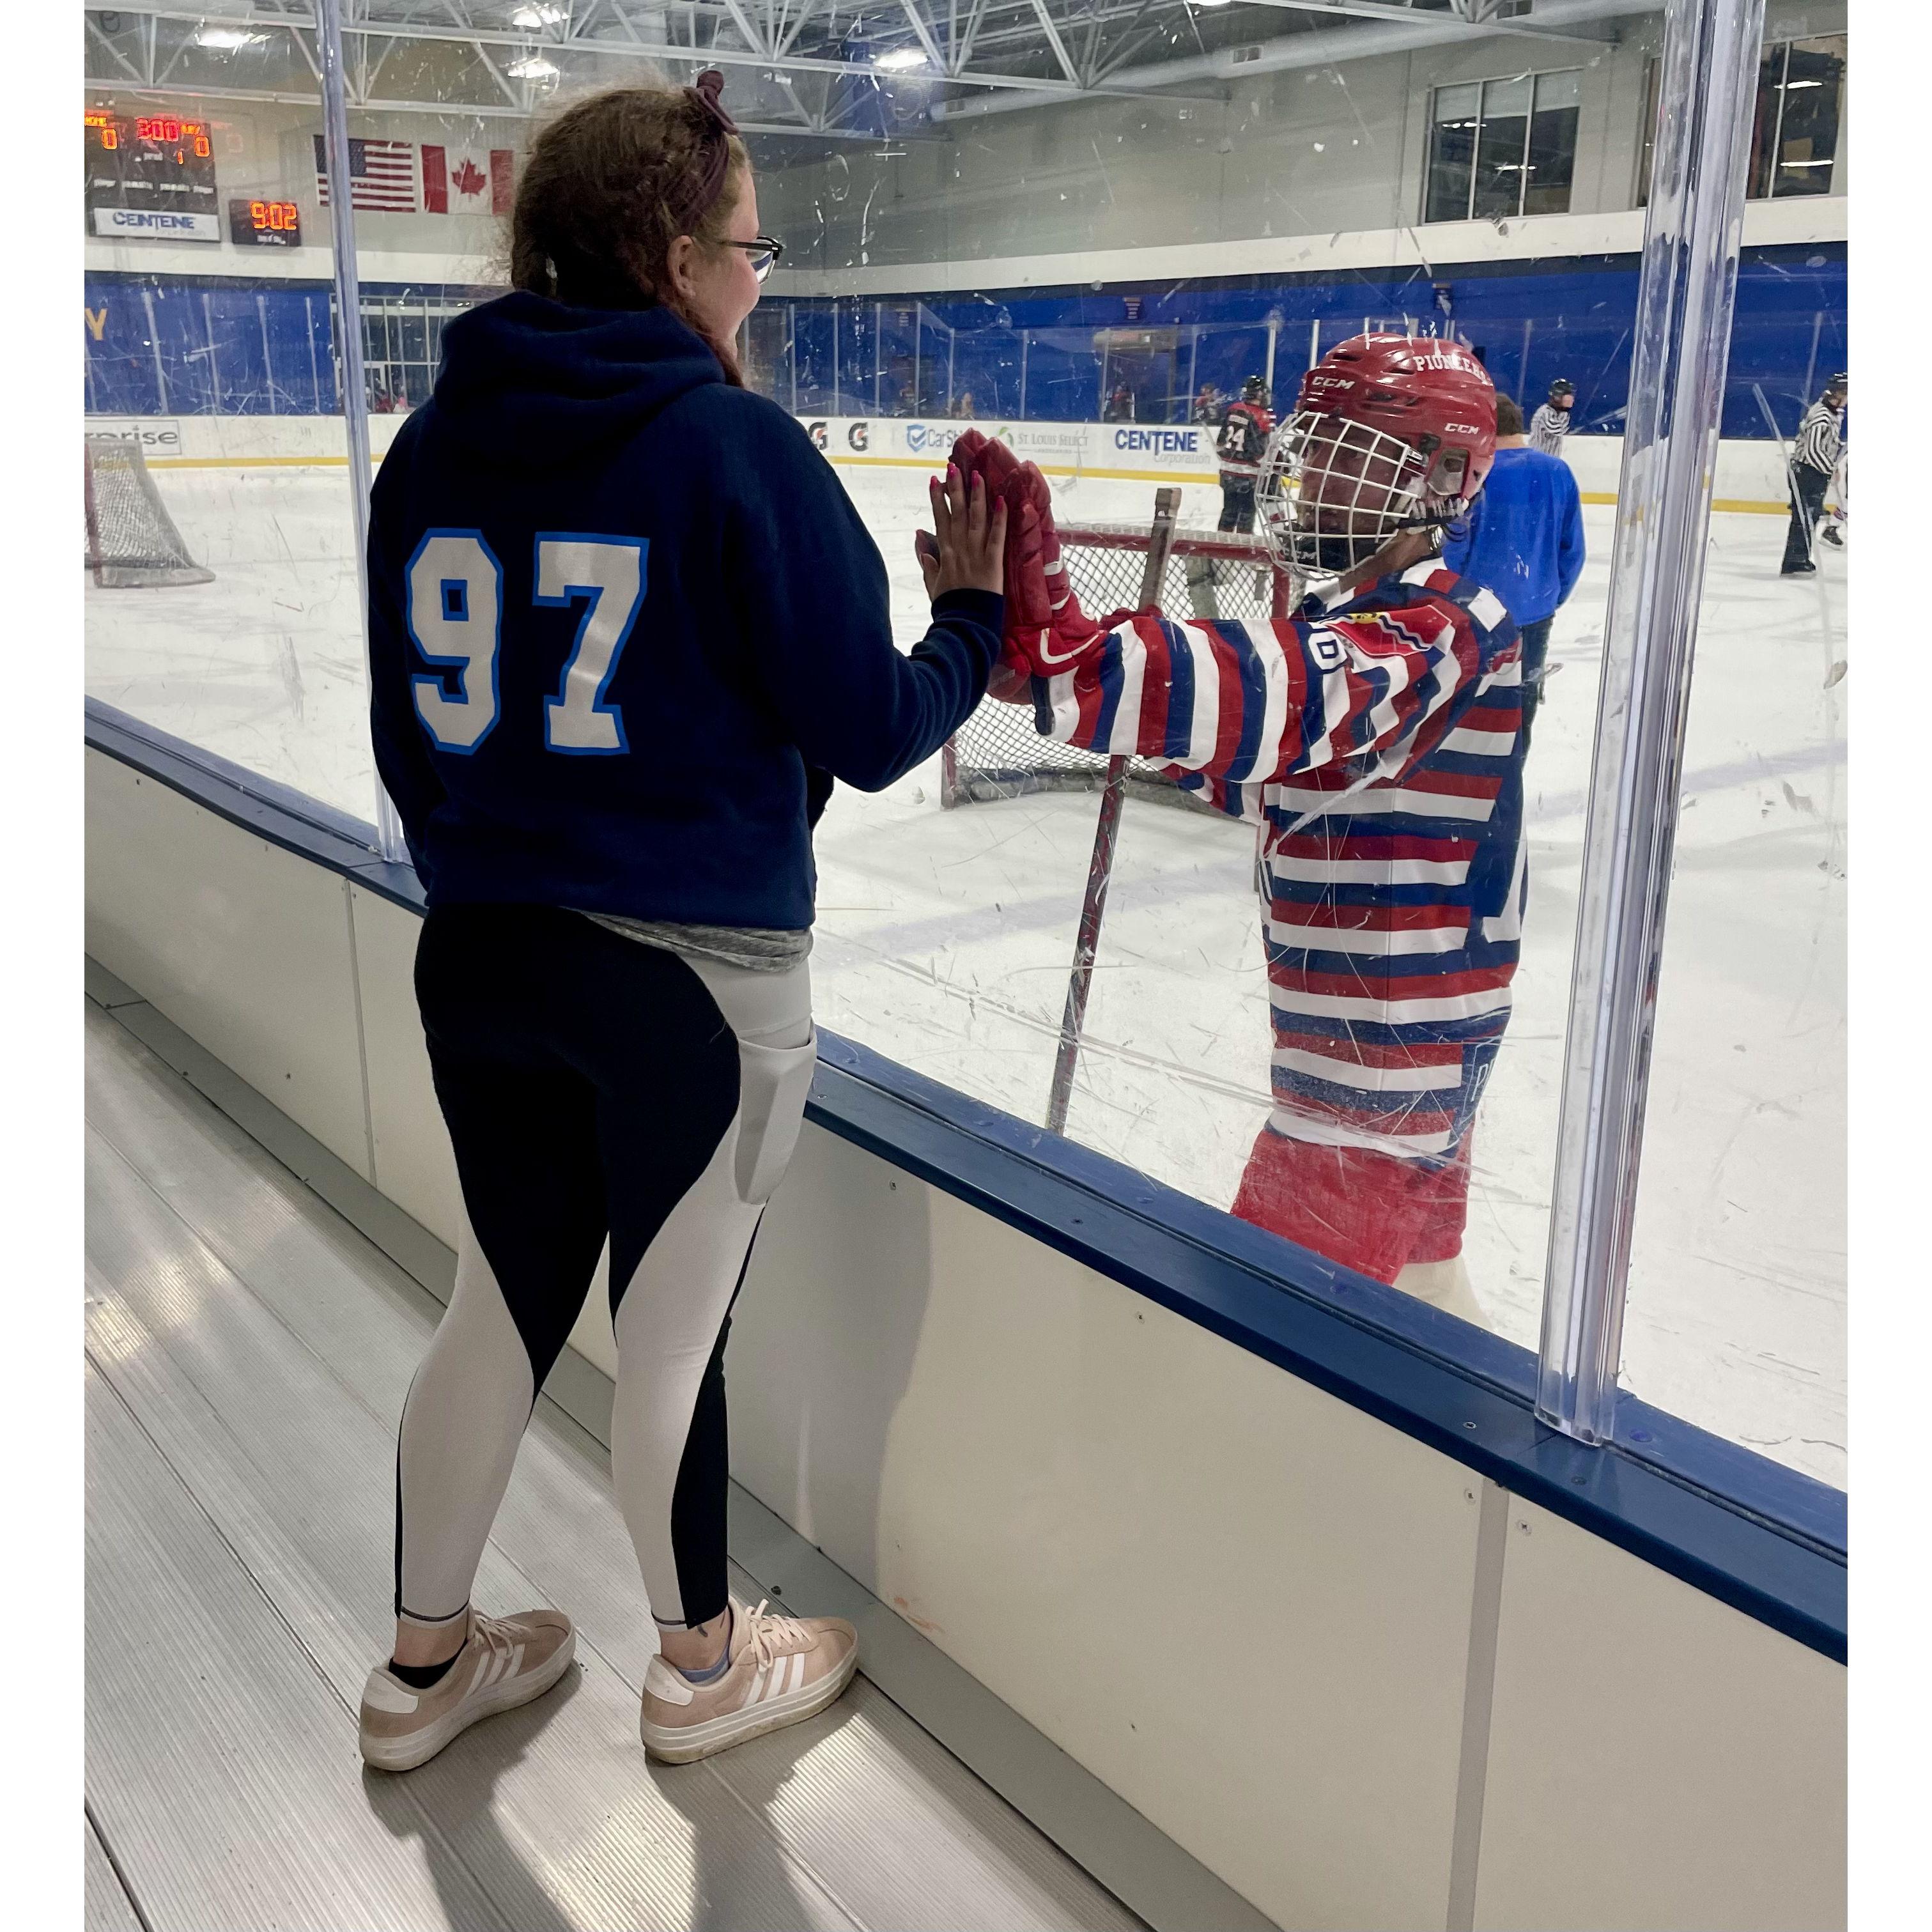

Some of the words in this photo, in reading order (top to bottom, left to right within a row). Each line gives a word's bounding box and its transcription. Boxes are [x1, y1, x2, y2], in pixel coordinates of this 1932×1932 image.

[113, 212, 196, 231] CENTENE
[1312, 376, 1356, 389] CCM
[1444, 422, 1480, 435] CCM
[1115, 429, 1198, 456] CENTENE
[1154, 453, 1211, 468] Corporation
[404, 527, 651, 756] 97
